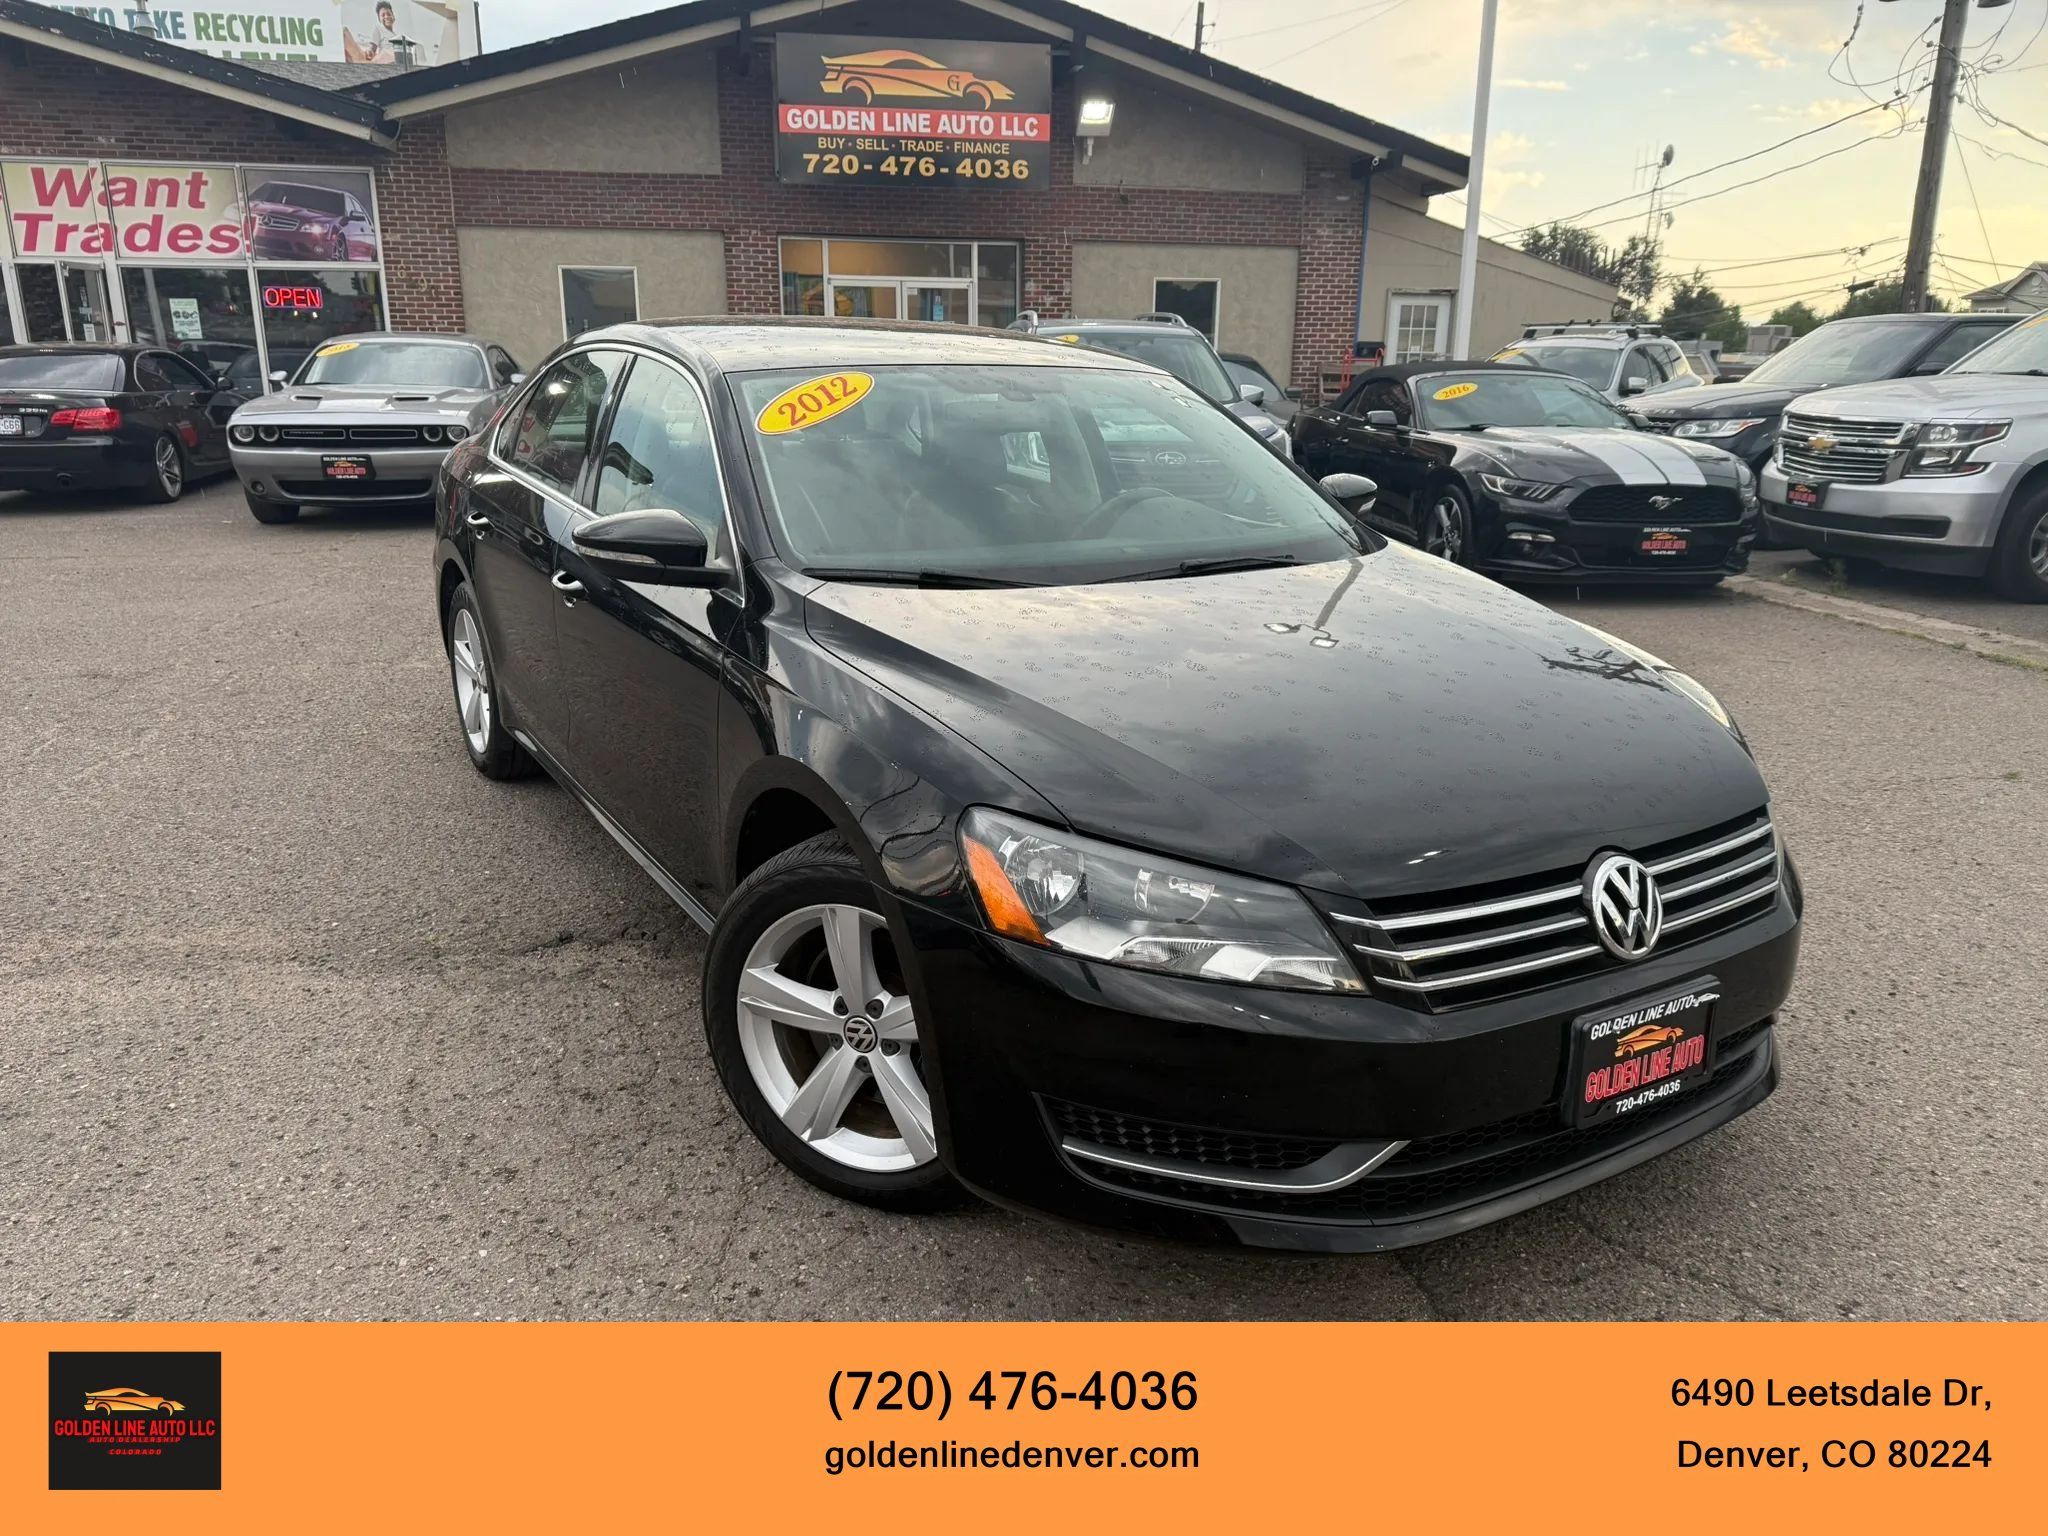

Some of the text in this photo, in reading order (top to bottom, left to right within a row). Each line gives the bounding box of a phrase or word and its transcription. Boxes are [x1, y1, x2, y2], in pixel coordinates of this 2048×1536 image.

[123, 8, 186, 40] TKE
[193, 11, 323, 46] RECYCLING
[787, 108, 1039, 137] GOLDEN LINE AUTO LLC
[817, 137, 1010, 154] BUY SELL TRADE FINANCE
[30, 166, 208, 209] Want
[13, 212, 257, 254] Trades!
[264, 287, 321, 308] OPEN
[777, 376, 859, 427] 2012
[1442, 384, 1470, 399] 2016
[1591, 994, 1694, 1041] GOLDEN LINE AUTO
[1585, 1034, 1705, 1103] GOLDEN LINE AUTO
[1616, 1080, 1681, 1114] 720-476-4036
